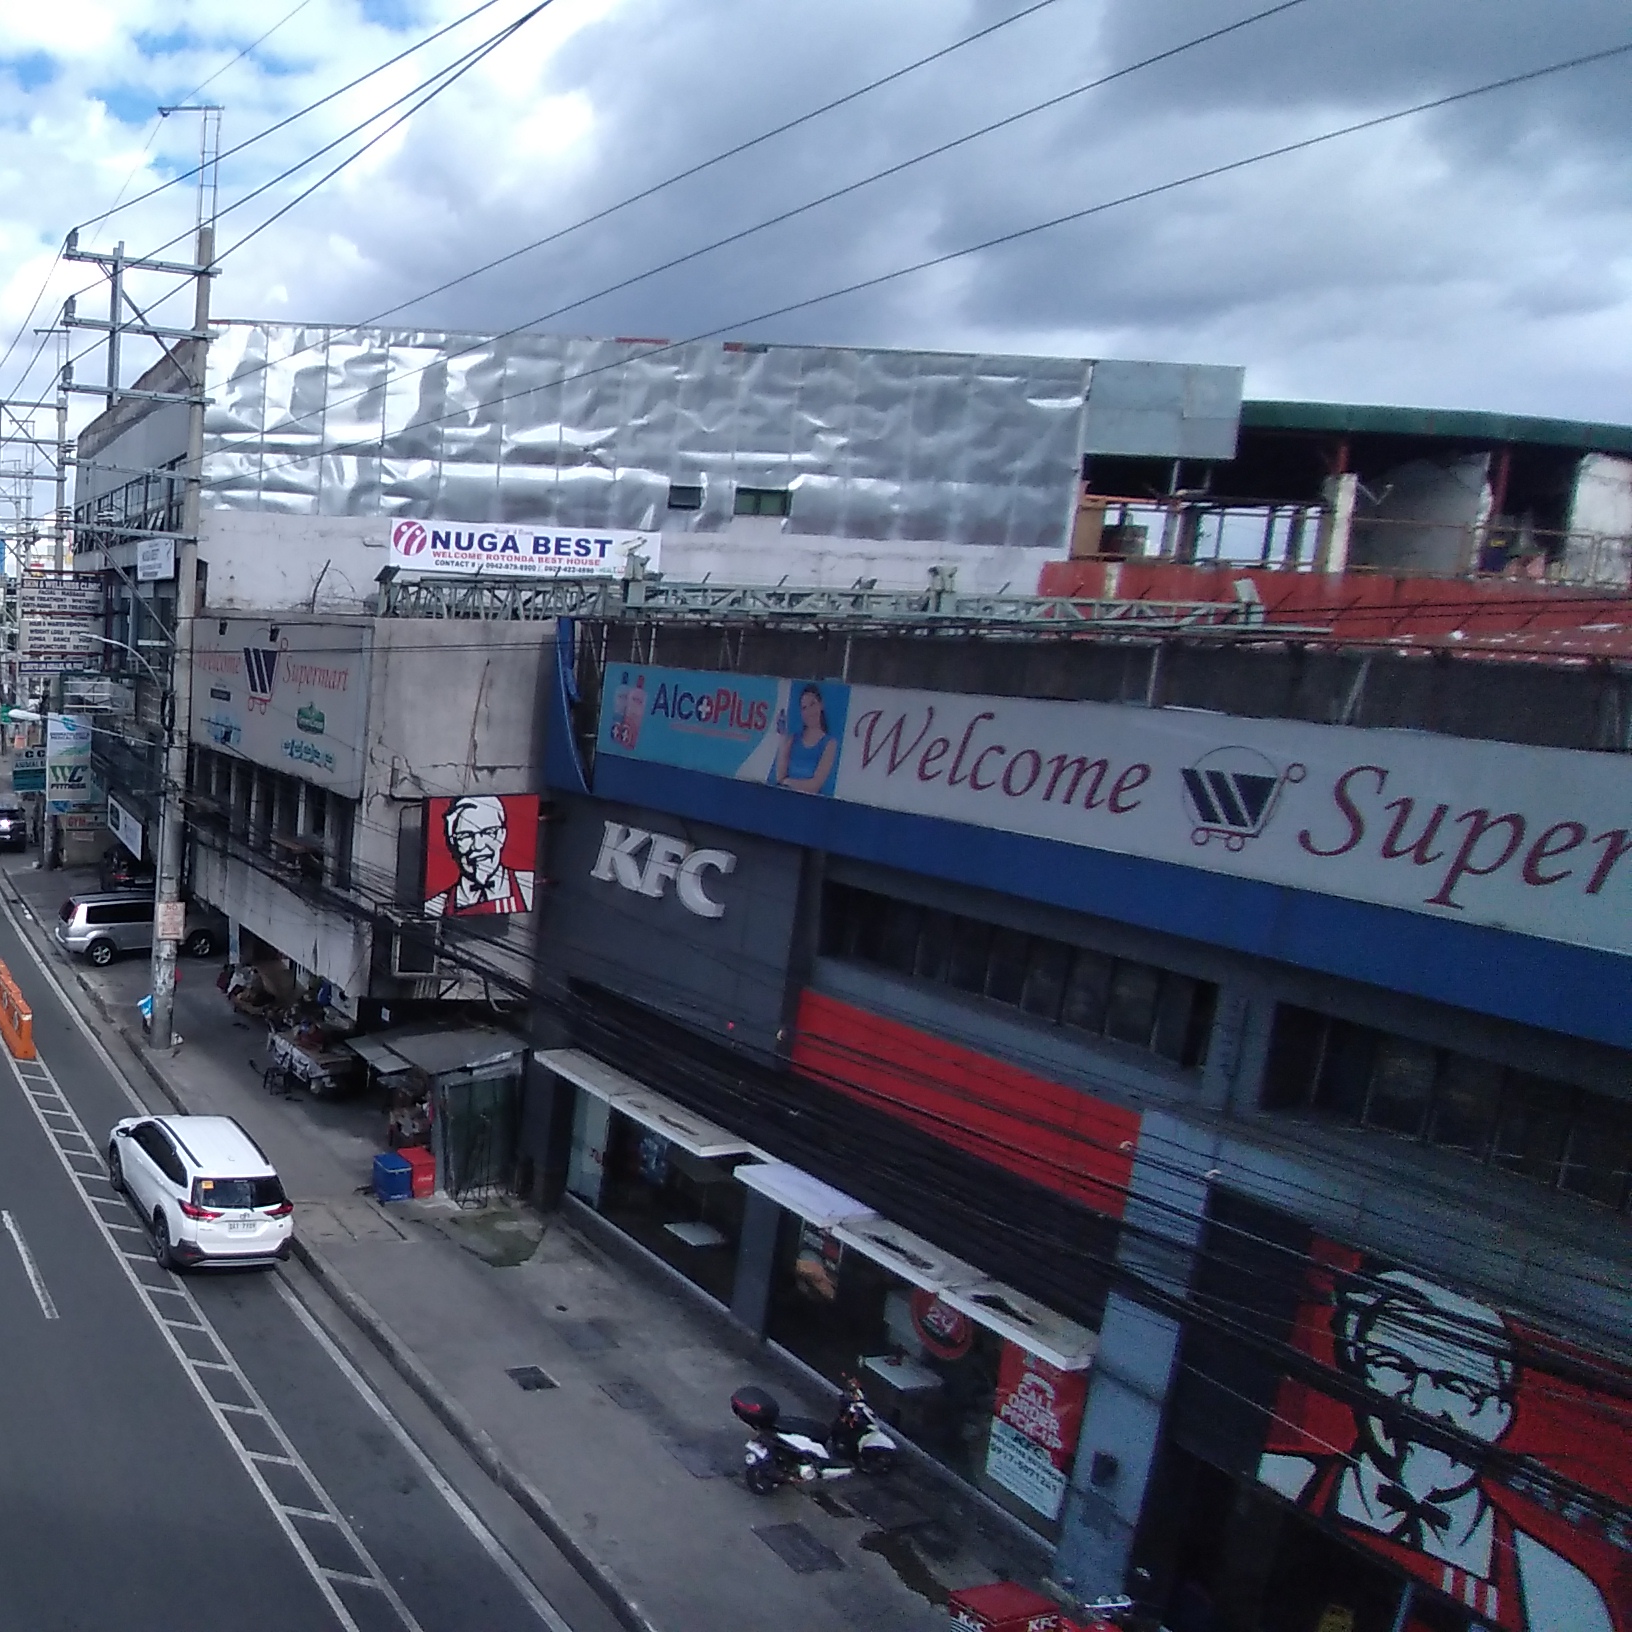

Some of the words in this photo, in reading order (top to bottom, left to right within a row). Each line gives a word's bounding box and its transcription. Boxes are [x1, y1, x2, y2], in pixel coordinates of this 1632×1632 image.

[431, 530, 520, 553] NUGA
[532, 536, 613, 558] BEST
[432, 551, 482, 560] WELCOME
[485, 554, 535, 563] ROTONDA
[538, 556, 561, 564] BEST
[566, 558, 601, 566] HOUSE
[434, 560, 469, 568] CONTACT
[45, 580, 79, 589] WELLNESS
[80, 582, 101, 591] CLINIC
[283, 655, 349, 693] Supermart
[650, 682, 769, 731] AlcoPlus
[853, 706, 1152, 814] Welcome
[1298, 764, 1632, 911] Super
[590, 820, 738, 918] KFC
[1009, 1392, 1060, 1434] ORDER
[1018, 1382, 1055, 1417] CALL
[1027, 1614, 1060, 1632] KFC
